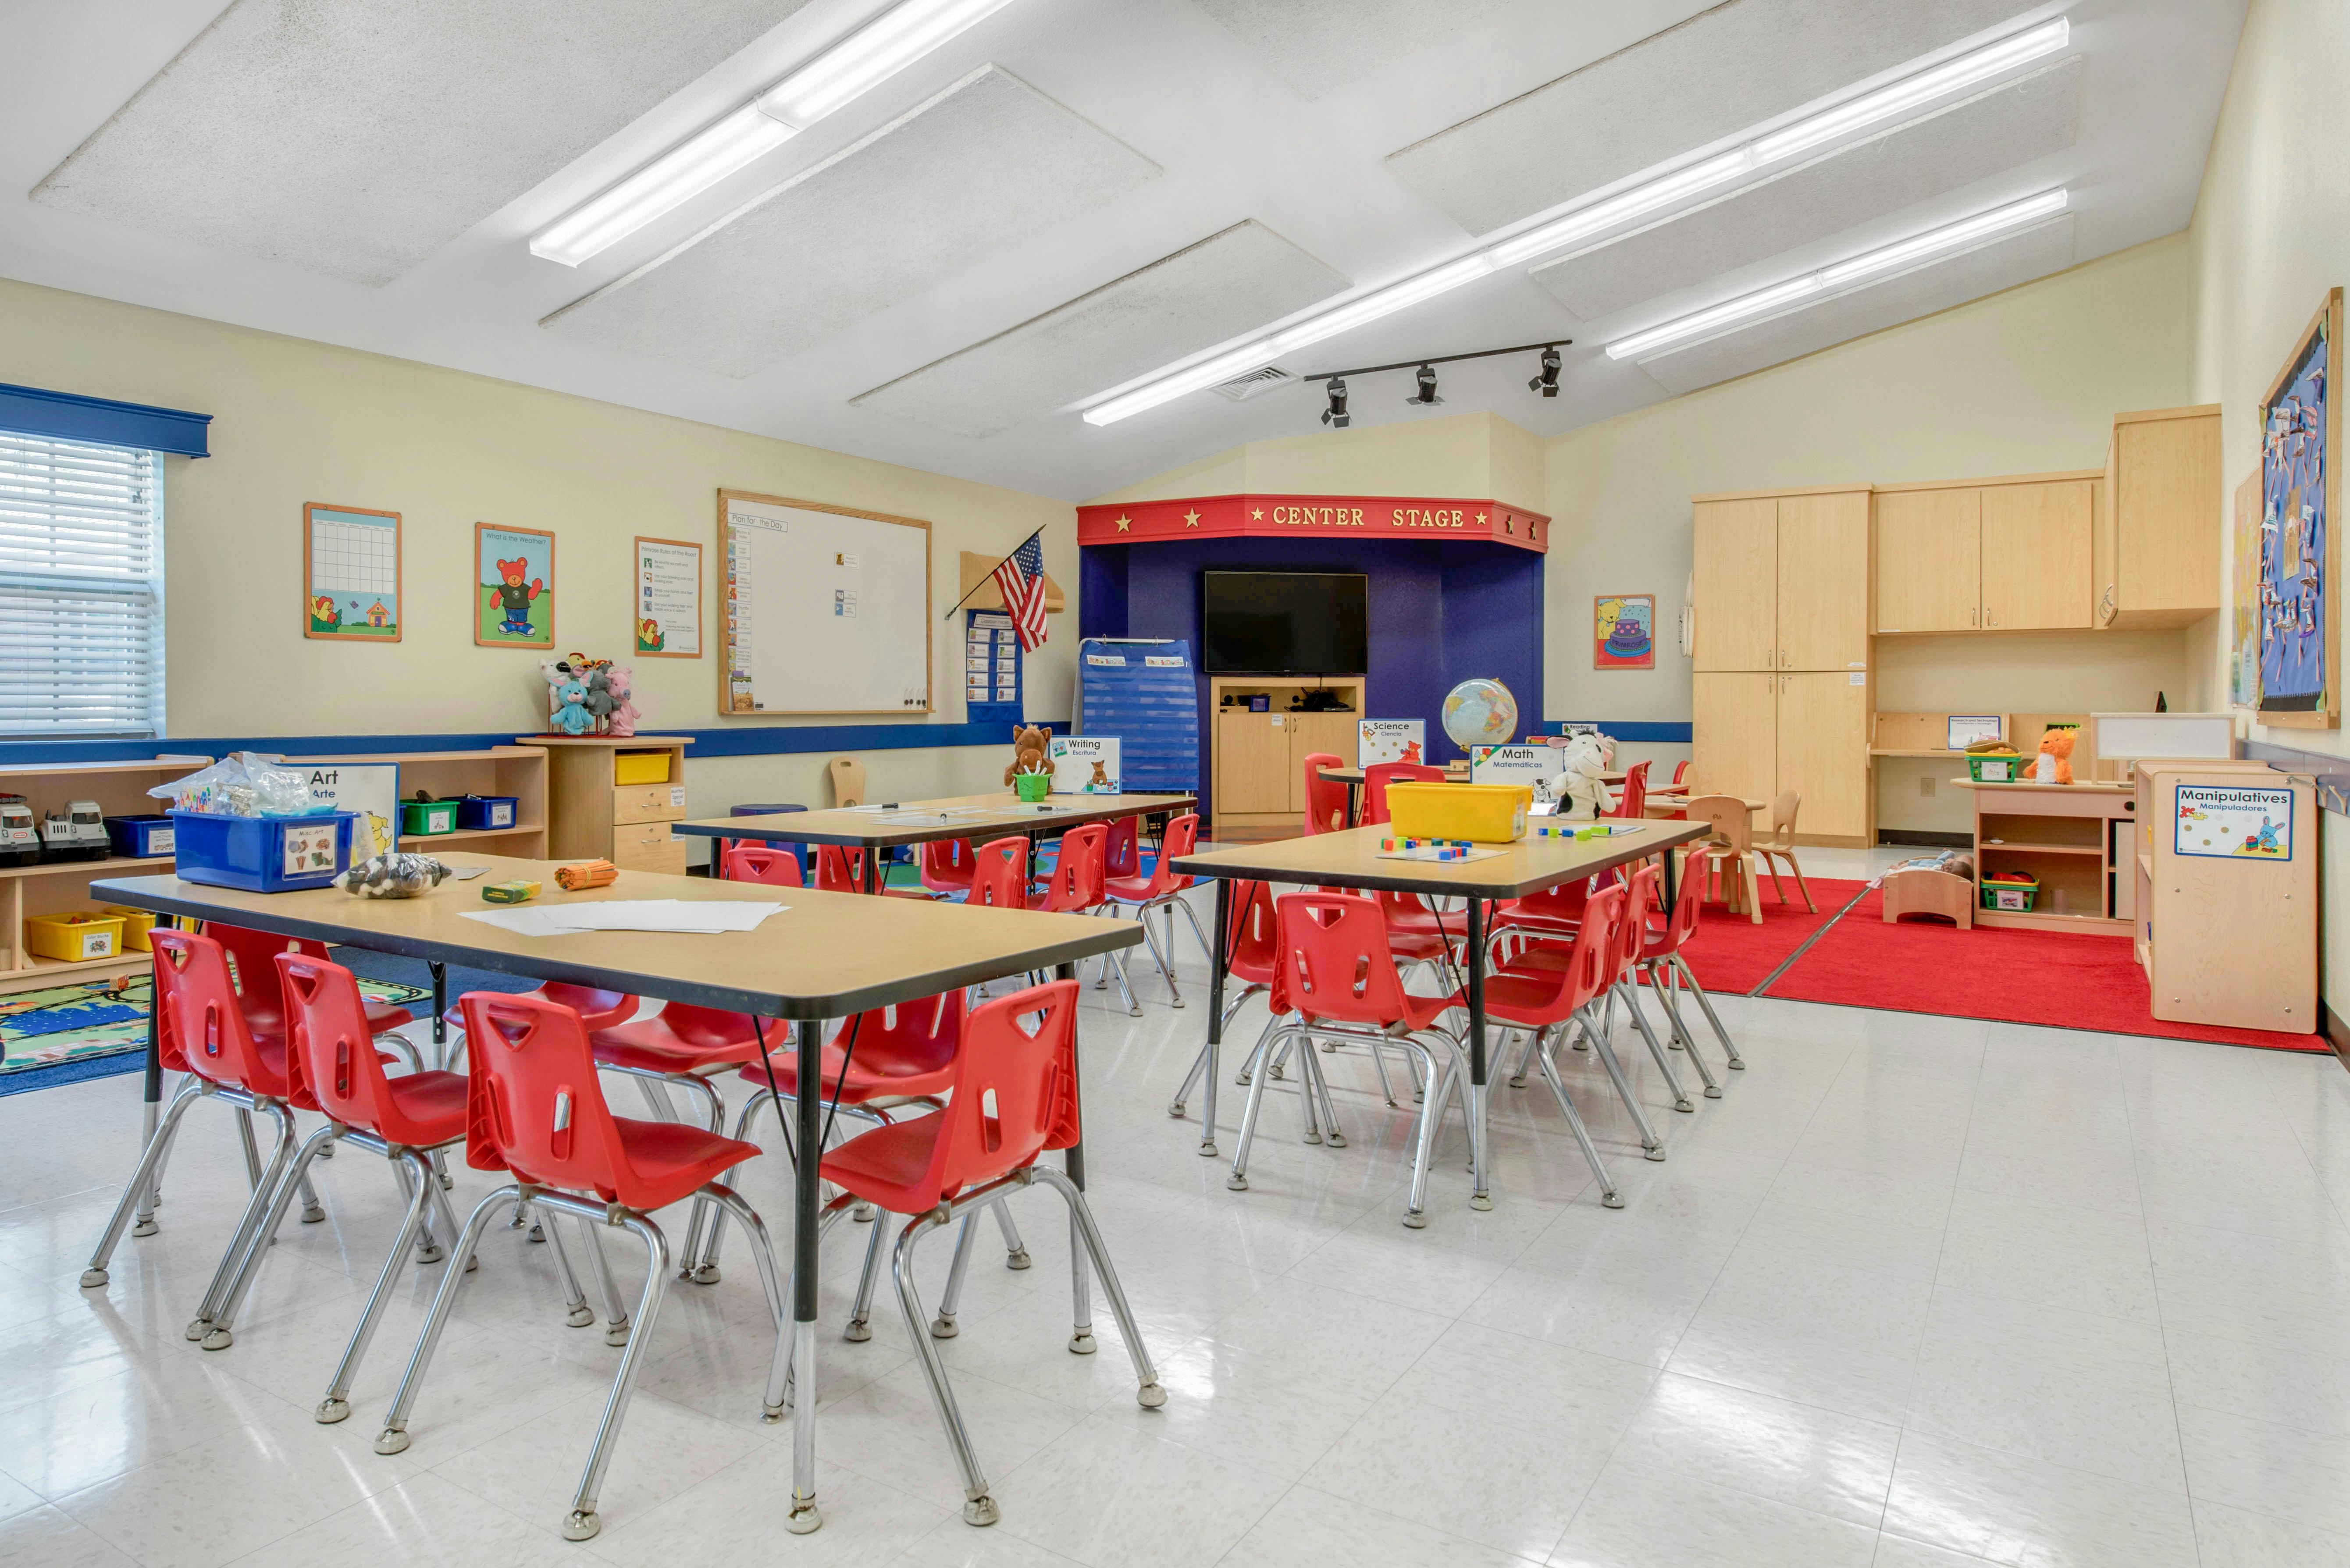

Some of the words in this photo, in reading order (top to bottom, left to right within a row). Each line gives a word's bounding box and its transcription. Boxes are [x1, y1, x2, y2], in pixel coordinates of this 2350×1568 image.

[1273, 506, 1364, 526] CENTER
[1392, 508, 1463, 527] STAGE
[732, 514, 745, 523] Plan
[747, 516, 755, 524] for
[771, 521, 783, 530] Day
[519, 536, 546, 545] Weather?
[1612, 638, 1643, 648] PRIMROSE
[1068, 740, 1100, 750] Writing
[1502, 749, 1534, 759] Math
[310, 770, 338, 785] Art
[313, 789, 336, 798] Arte
[2180, 789, 2288, 804] Manipulatives
[2199, 803, 2267, 812] Manipuladores
